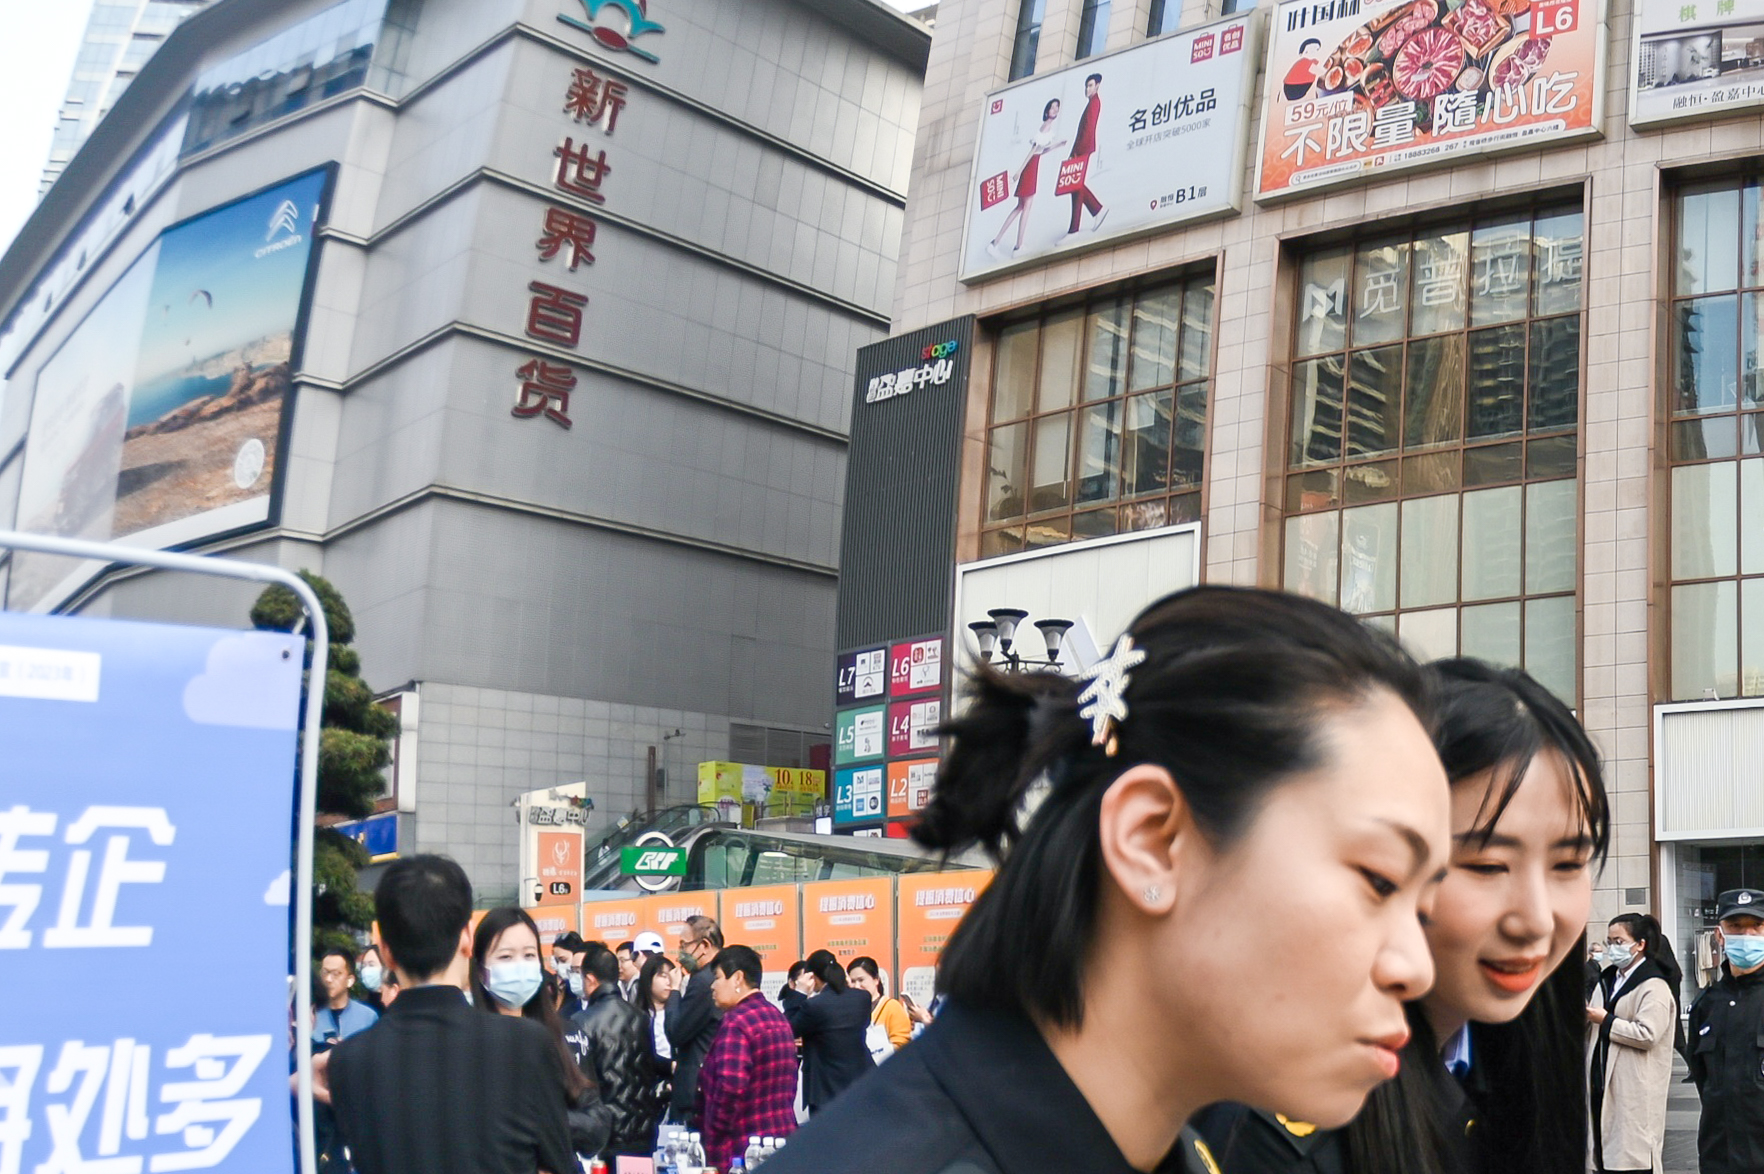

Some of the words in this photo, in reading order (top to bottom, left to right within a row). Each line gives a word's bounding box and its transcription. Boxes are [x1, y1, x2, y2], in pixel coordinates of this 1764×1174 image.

[1535, 6, 1574, 35] L6
[1128, 87, 1217, 133] 名创优品
[1126, 118, 1212, 150] 全球开店突破5000家
[1280, 101, 1417, 166] 不限量
[508, 66, 628, 430] 新世界百货
[838, 666, 856, 687] L7
[891, 657, 910, 677] L6
[838, 725, 855, 745] L5
[891, 715, 910, 735] L4
[836, 785, 853, 804] L3
[890, 777, 908, 797] L2
